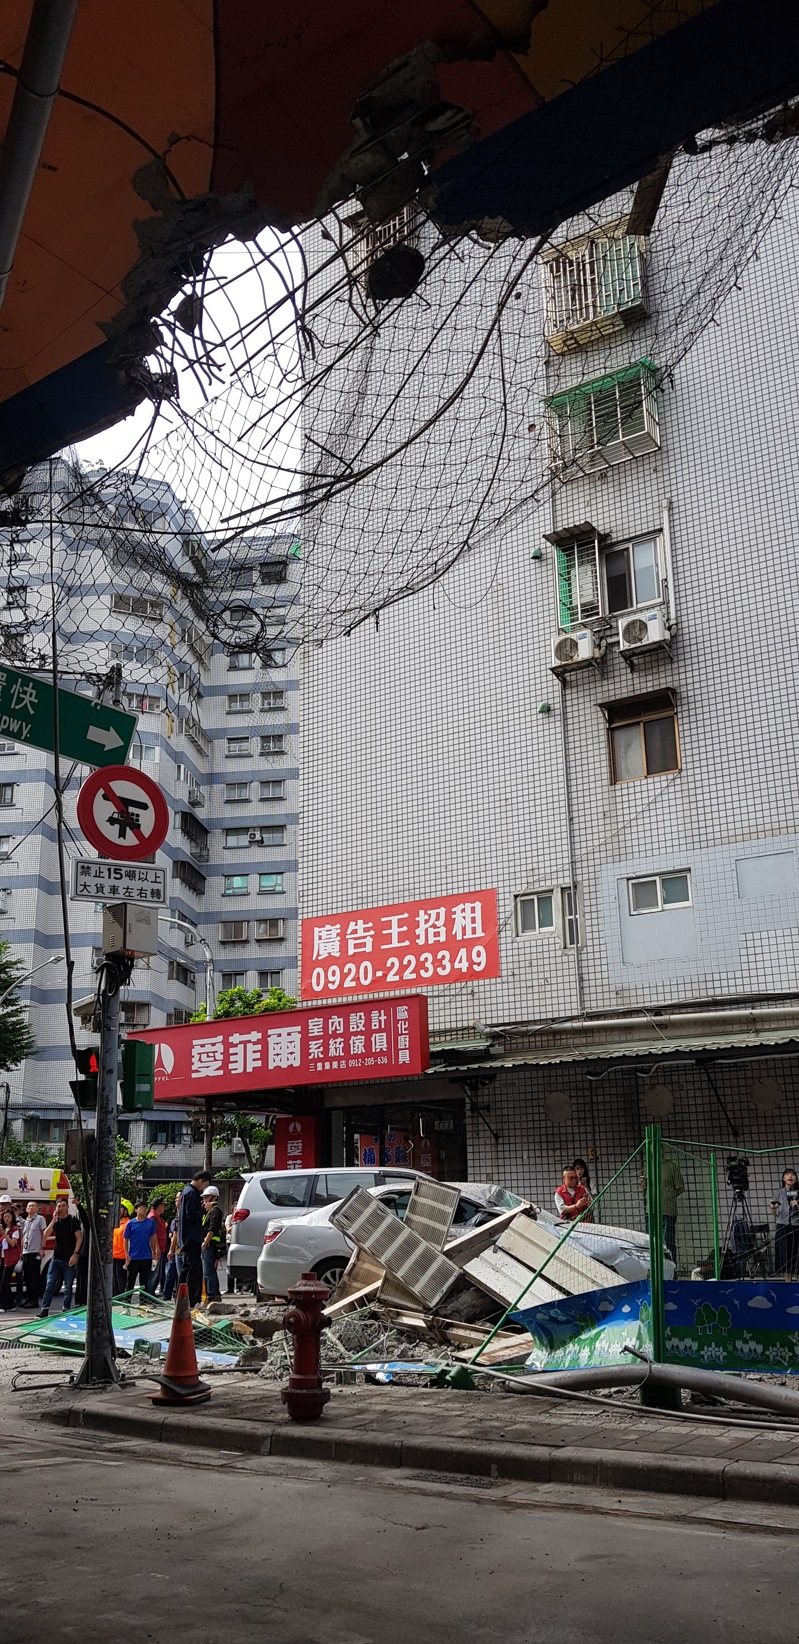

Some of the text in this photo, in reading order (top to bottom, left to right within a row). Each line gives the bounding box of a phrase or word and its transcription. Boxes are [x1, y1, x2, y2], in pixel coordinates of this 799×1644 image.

[0, 671, 39, 715] 快
[0, 714, 32, 740] pwy.
[80, 865, 162, 884] 禁止15噸以上
[79, 881, 162, 900] 大貨車左右轉
[312, 901, 485, 961] 廣告王招租
[311, 945, 487, 992] 0920-223349
[308, 1009, 387, 1037] 室內設計
[396, 1005, 410, 1064] 歐化廚具
[191, 1026, 302, 1079] 愛菲爾
[308, 1032, 388, 1059] 系統傢俱
[348, 1055, 388, 1067] 0912-205-636
